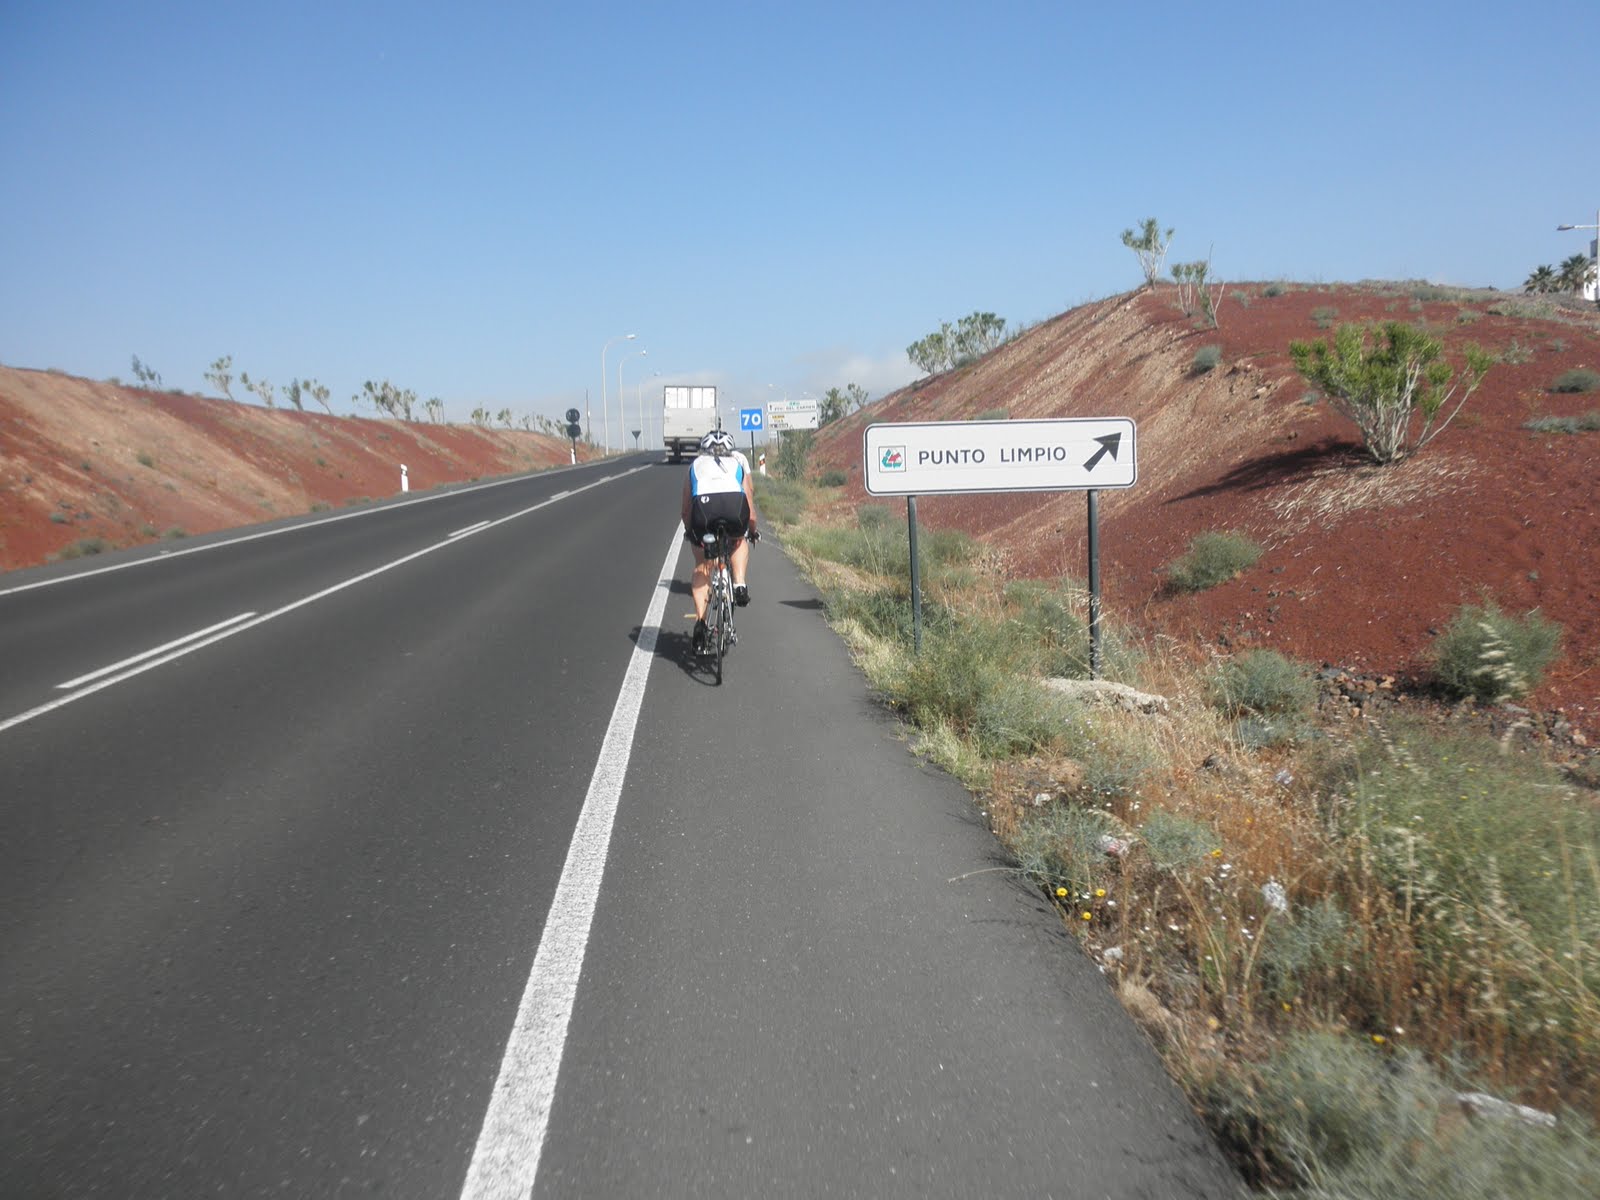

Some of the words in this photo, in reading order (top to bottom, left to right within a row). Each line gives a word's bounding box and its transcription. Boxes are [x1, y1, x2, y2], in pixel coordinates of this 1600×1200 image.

[741, 413, 761, 426] 70
[918, 449, 985, 465] PUNTO
[1000, 446, 1066, 462] LIMPIO
